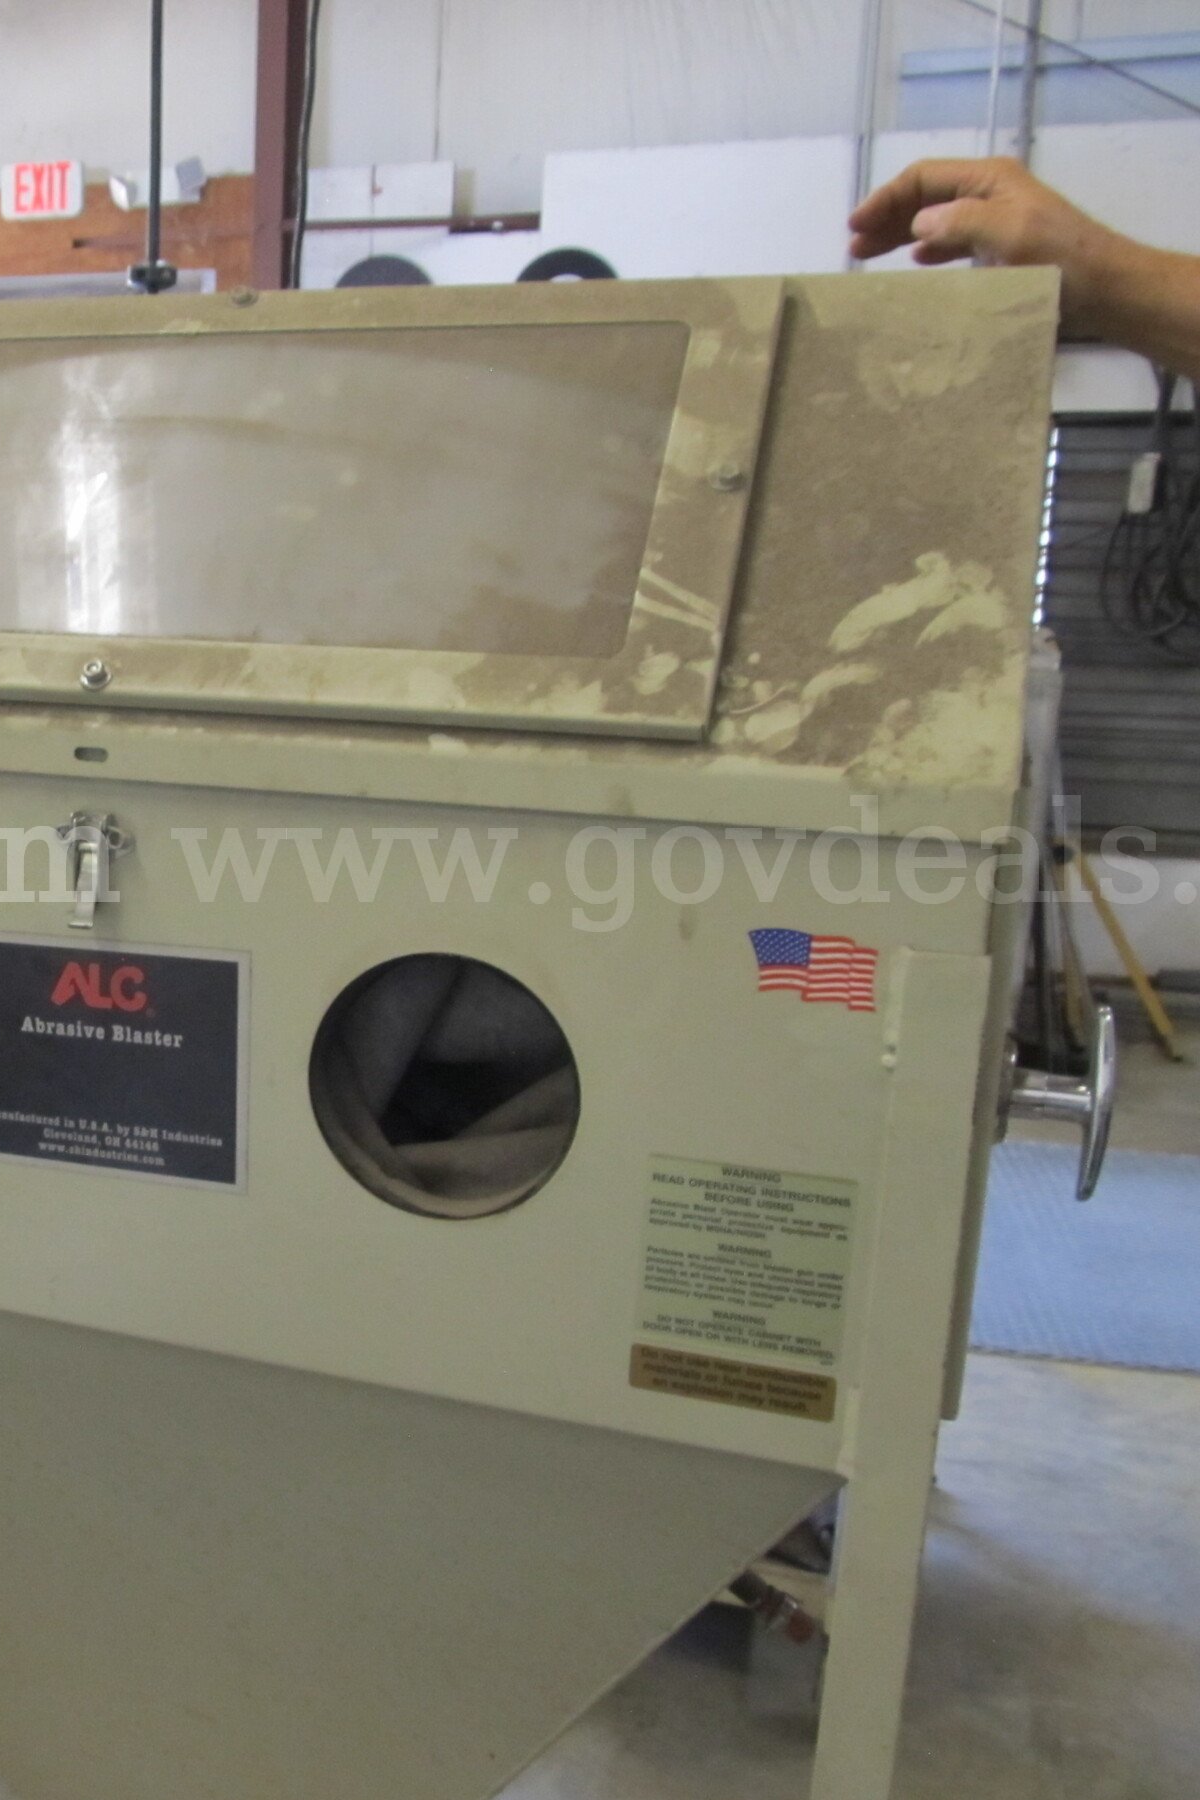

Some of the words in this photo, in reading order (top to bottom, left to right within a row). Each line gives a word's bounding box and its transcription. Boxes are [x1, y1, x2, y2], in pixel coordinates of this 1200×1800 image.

[15, 161, 70, 213] EXIT
[51, 961, 147, 1012] ALC
[21, 1016, 105, 1040] Abrasive
[112, 1025, 183, 1048] Blaster
[64, 1119, 75, 1129] in
[117, 1123, 131, 1138] by
[161, 1129, 223, 1147] Industries
[722, 1167, 781, 1182] WARNING
[653, 1173, 684, 1185] READ
[689, 1178, 756, 1194] OPERATING
[762, 1187, 850, 1207] INSTRUCTIONS
[704, 1192, 750, 1206] BEFORE
[757, 1199, 793, 1211] USING
[718, 1243, 771, 1258] WARNING
[657, 1315, 671, 1323] DO
[675, 1318, 694, 1326] NOT
[713, 1310, 765, 1325] WARNING
[643, 1321, 671, 1333] DOOR
[675, 1326, 702, 1338] OPEN
[706, 1331, 719, 1340] OR
[725, 1334, 748, 1345] WITH
